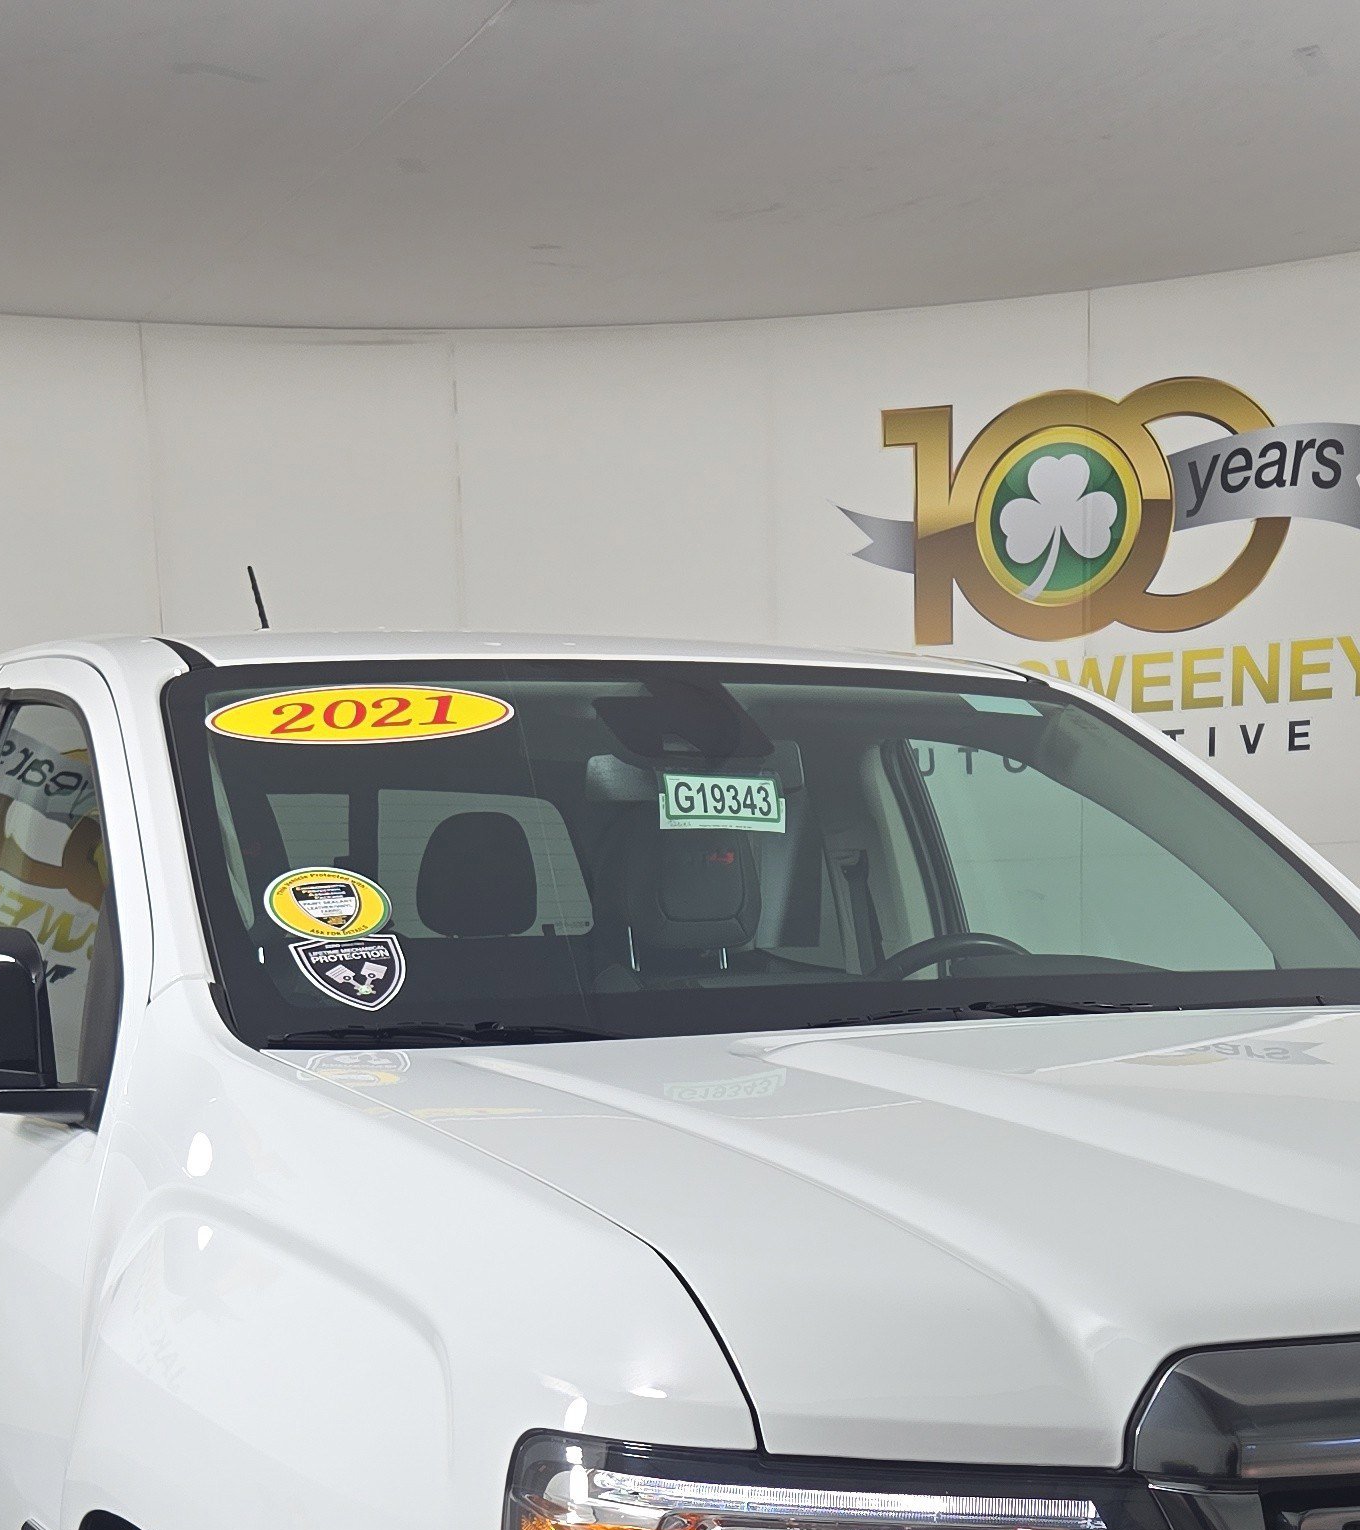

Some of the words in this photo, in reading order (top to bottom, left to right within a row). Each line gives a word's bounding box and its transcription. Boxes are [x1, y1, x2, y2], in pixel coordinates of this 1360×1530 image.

[1184, 434, 1345, 516] years
[882, 376, 1290, 645] 100
[270, 695, 457, 734] 2021
[675, 782, 771, 816] G19343
[310, 948, 390, 964] PROTECTION
